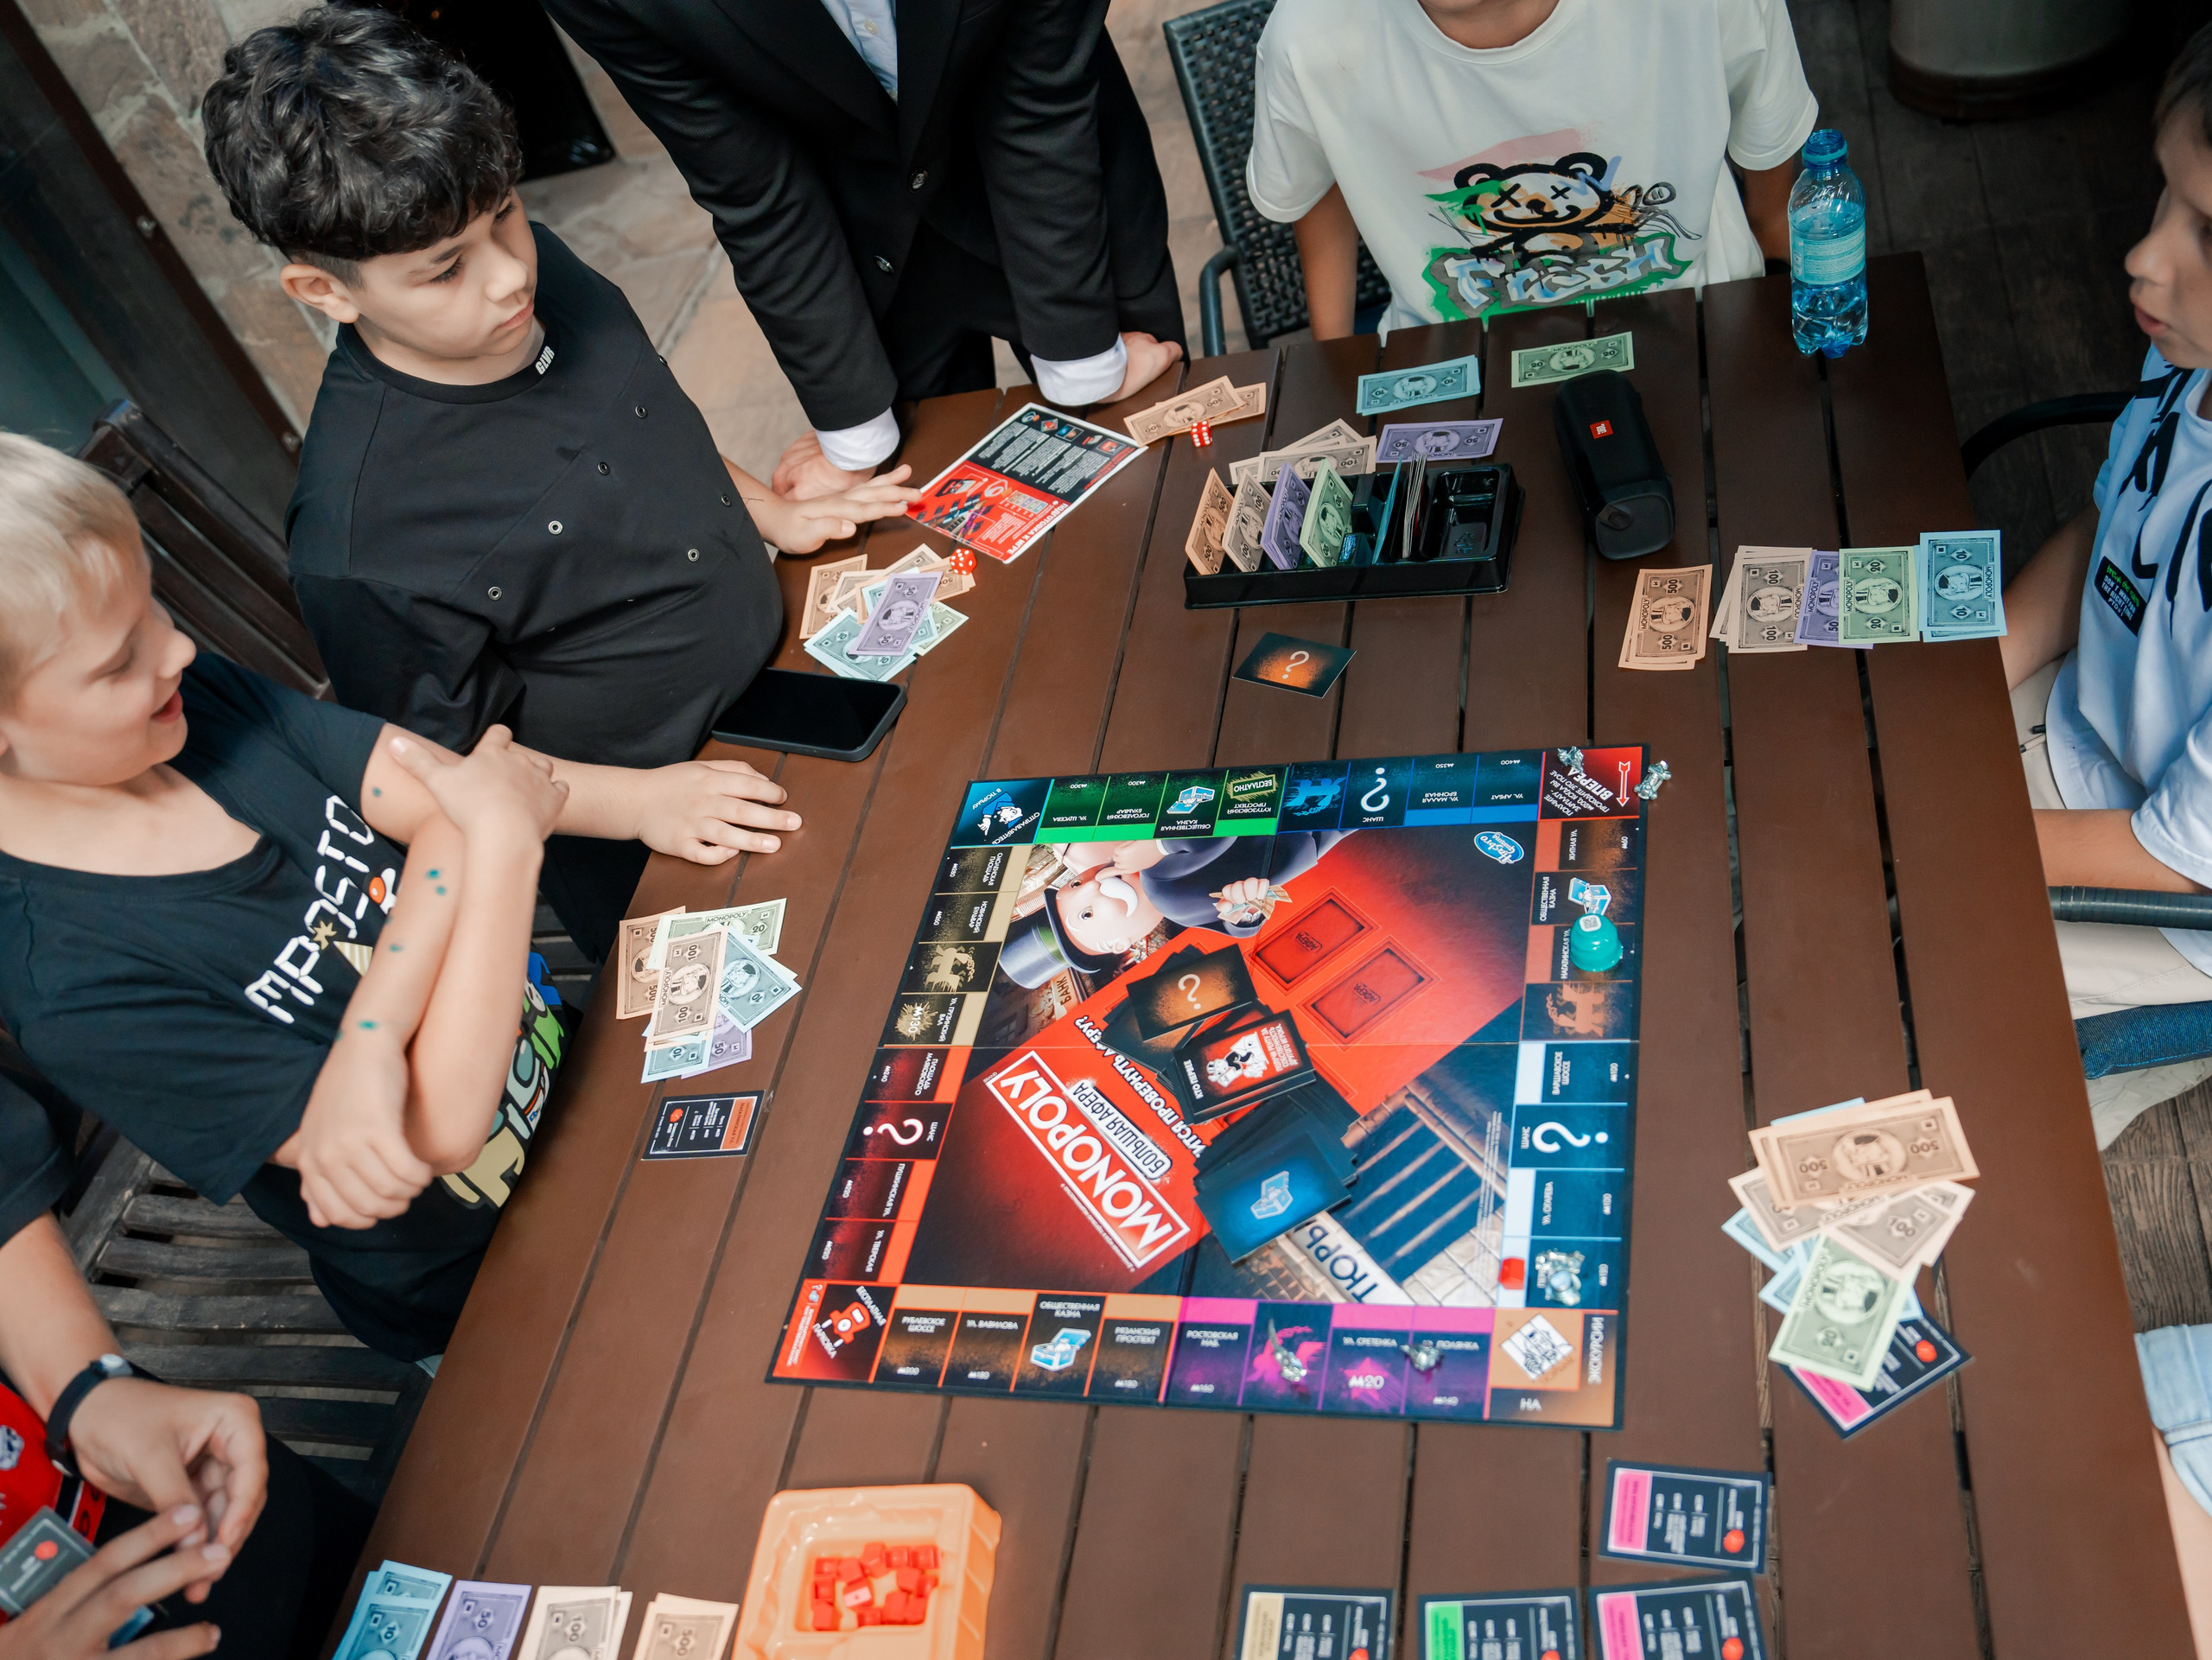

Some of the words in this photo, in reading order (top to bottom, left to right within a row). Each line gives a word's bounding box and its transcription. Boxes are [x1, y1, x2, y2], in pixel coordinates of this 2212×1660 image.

[535, 345, 556, 375] CLVR
[1205, 398, 1224, 407] 500
[1218, 497, 1228, 513] 500
[1255, 494, 1263, 511] 100
[1028, 503, 1069, 537] ПОДГОТОВКА
[1007, 539, 1026, 555] ИГРЕ
[1957, 549, 1967, 561] 10
[1870, 560, 1880, 574] 20
[1668, 578, 1679, 595] 500
[1771, 569, 1780, 587] 100
[1984, 566, 1993, 599] MONOPOLY
[1808, 580, 1818, 614] MONOPOLY
[1846, 580, 1855, 614] MONOPOLY
[2110, 590, 2123, 608] RIGHT
[1641, 597, 1649, 631] MONOPOLY
[1956, 607, 1967, 617] 10
[1769, 625, 1777, 642] 100
[1870, 618, 1880, 630] 20
[1661, 633, 1673, 650] 500
[1234, 779, 1273, 792] БЕСПЛАТНО
[1550, 770, 1567, 783] ПОЛЕ
[1550, 779, 1560, 788] ВЫ
[1565, 780, 1579, 791] ЭТО
[972, 792, 996, 811] ТЮРЬМУ
[1553, 792, 1581, 812] ЗАРПЛАТУ
[1560, 785, 1579, 800] КОГДА
[1576, 788, 1610, 812] ПРОХОДИТЕ
[1543, 794, 1573, 816] ПОЛУЧИТЕ
[992, 811, 1040, 845] ОТПРАВЛЯЙТЕСЬ
[1160, 823, 1211, 831] ОБЩЕСТВЕННАЯ
[1480, 836, 1513, 863] Hasbro
[1568, 837, 1577, 861] ЖИТНАЯ
[982, 855, 996, 883] ПЛОЩАДЬ
[988, 852, 1003, 886] СМОЛЕНСКАЯ
[1540, 876, 1550, 921] ОБЩЕСТВЕННАЯ
[1548, 888, 1557, 908] КАЗНА
[706, 911, 747, 924] MONOPOLY
[969, 906, 980, 928] БУЛЬВАР
[973, 900, 988, 933] НОВИНСКИЙ
[751, 925, 766, 934] 20
[1296, 932, 1319, 952] АФЕРА
[688, 944, 698, 961] 100
[1560, 938, 1570, 979] НАГАТИНСКАЯ
[661, 970, 671, 1007] MONOPOLY
[1057, 976, 1072, 1006] БАНК
[1353, 983, 1378, 1003] АФЕРА
[677, 1006, 689, 1023] 100
[937, 1014, 946, 1027] ВАЛ
[938, 1007, 955, 1042] ГРУЗИНСКИЙ
[1261, 1027, 1269, 1039] ЗА
[671, 1047, 683, 1059] 10
[714, 1041, 724, 1055] 50
[1262, 1037, 1275, 1055] РЕНТУ
[1268, 1027, 1289, 1068] СОБСТВЕННОСТЬ
[1285, 1043, 1299, 1066] ДРУГОГО
[1183, 1059, 1198, 1085] ПЕРВЕЕ
[1270, 1053, 1284, 1072] ПОЛУЧИ
[914, 1053, 933, 1096] МАЯКОВСКОГО
[923, 1059, 939, 1090] ПЛОЩАДЬ
[1552, 1051, 1563, 1096] ВАРШАВСКОЕ
[1561, 1061, 1571, 1085] ШОССЕ
[1113, 1053, 1179, 1126] ПРОВЕРНУТЬ
[1192, 1083, 1204, 1100] КТО
[1072, 1081, 1115, 1123] АФЕРА
[926, 1122, 939, 1142] ШАНС
[1521, 1126, 1531, 1149] ШАНС
[1107, 1114, 1165, 1173] БОЛЬШАЯ
[1911, 1141, 1939, 1154] 500
[1000, 1070, 1173, 1250] MONOPOLY
[1800, 1161, 1827, 1174] 500
[886, 1163, 906, 1207] ПУШКИНСКАЯ
[1542, 1180, 1554, 1214] ОГАРЕВА
[1891, 1217, 1916, 1238] 100
[865, 1240, 881, 1273] ТВЕРСКАЯ
[1294, 1219, 1380, 1303] ТЮРЬ
[1803, 1256, 1829, 1309] MONOPOLY
[855, 1285, 887, 1326] БЕСПЛАТНАЯ
[1039, 1301, 1100, 1312] ОБЩЕСТВЕННАЯ
[1054, 1309, 1082, 1319] КАЗНА
[901, 1316, 946, 1326] РУБЛЕВСКОЕ
[907, 1324, 936, 1333] ШОССЕ
[977, 1320, 1019, 1331] ВАВИЛОВА
[812, 1322, 837, 1359] ПАРКОВКА
[1115, 1326, 1160, 1338] РЯЗАНСКИЙ
[1116, 1333, 1156, 1345] ПРОСПЕКТ
[1186, 1330, 1238, 1340] РОСТОВСКАЯ
[1356, 1337, 1397, 1347] СРЕТЕНКА
[1435, 1340, 1479, 1351] ПОЛЯНКА
[1587, 1316, 1605, 1384] ЭКСКУРСИИ
[1520, 1397, 1541, 1411] НА
[476, 1609, 491, 1628] 50
[565, 1614, 585, 1643] 100
[676, 1628, 695, 1657] 500
